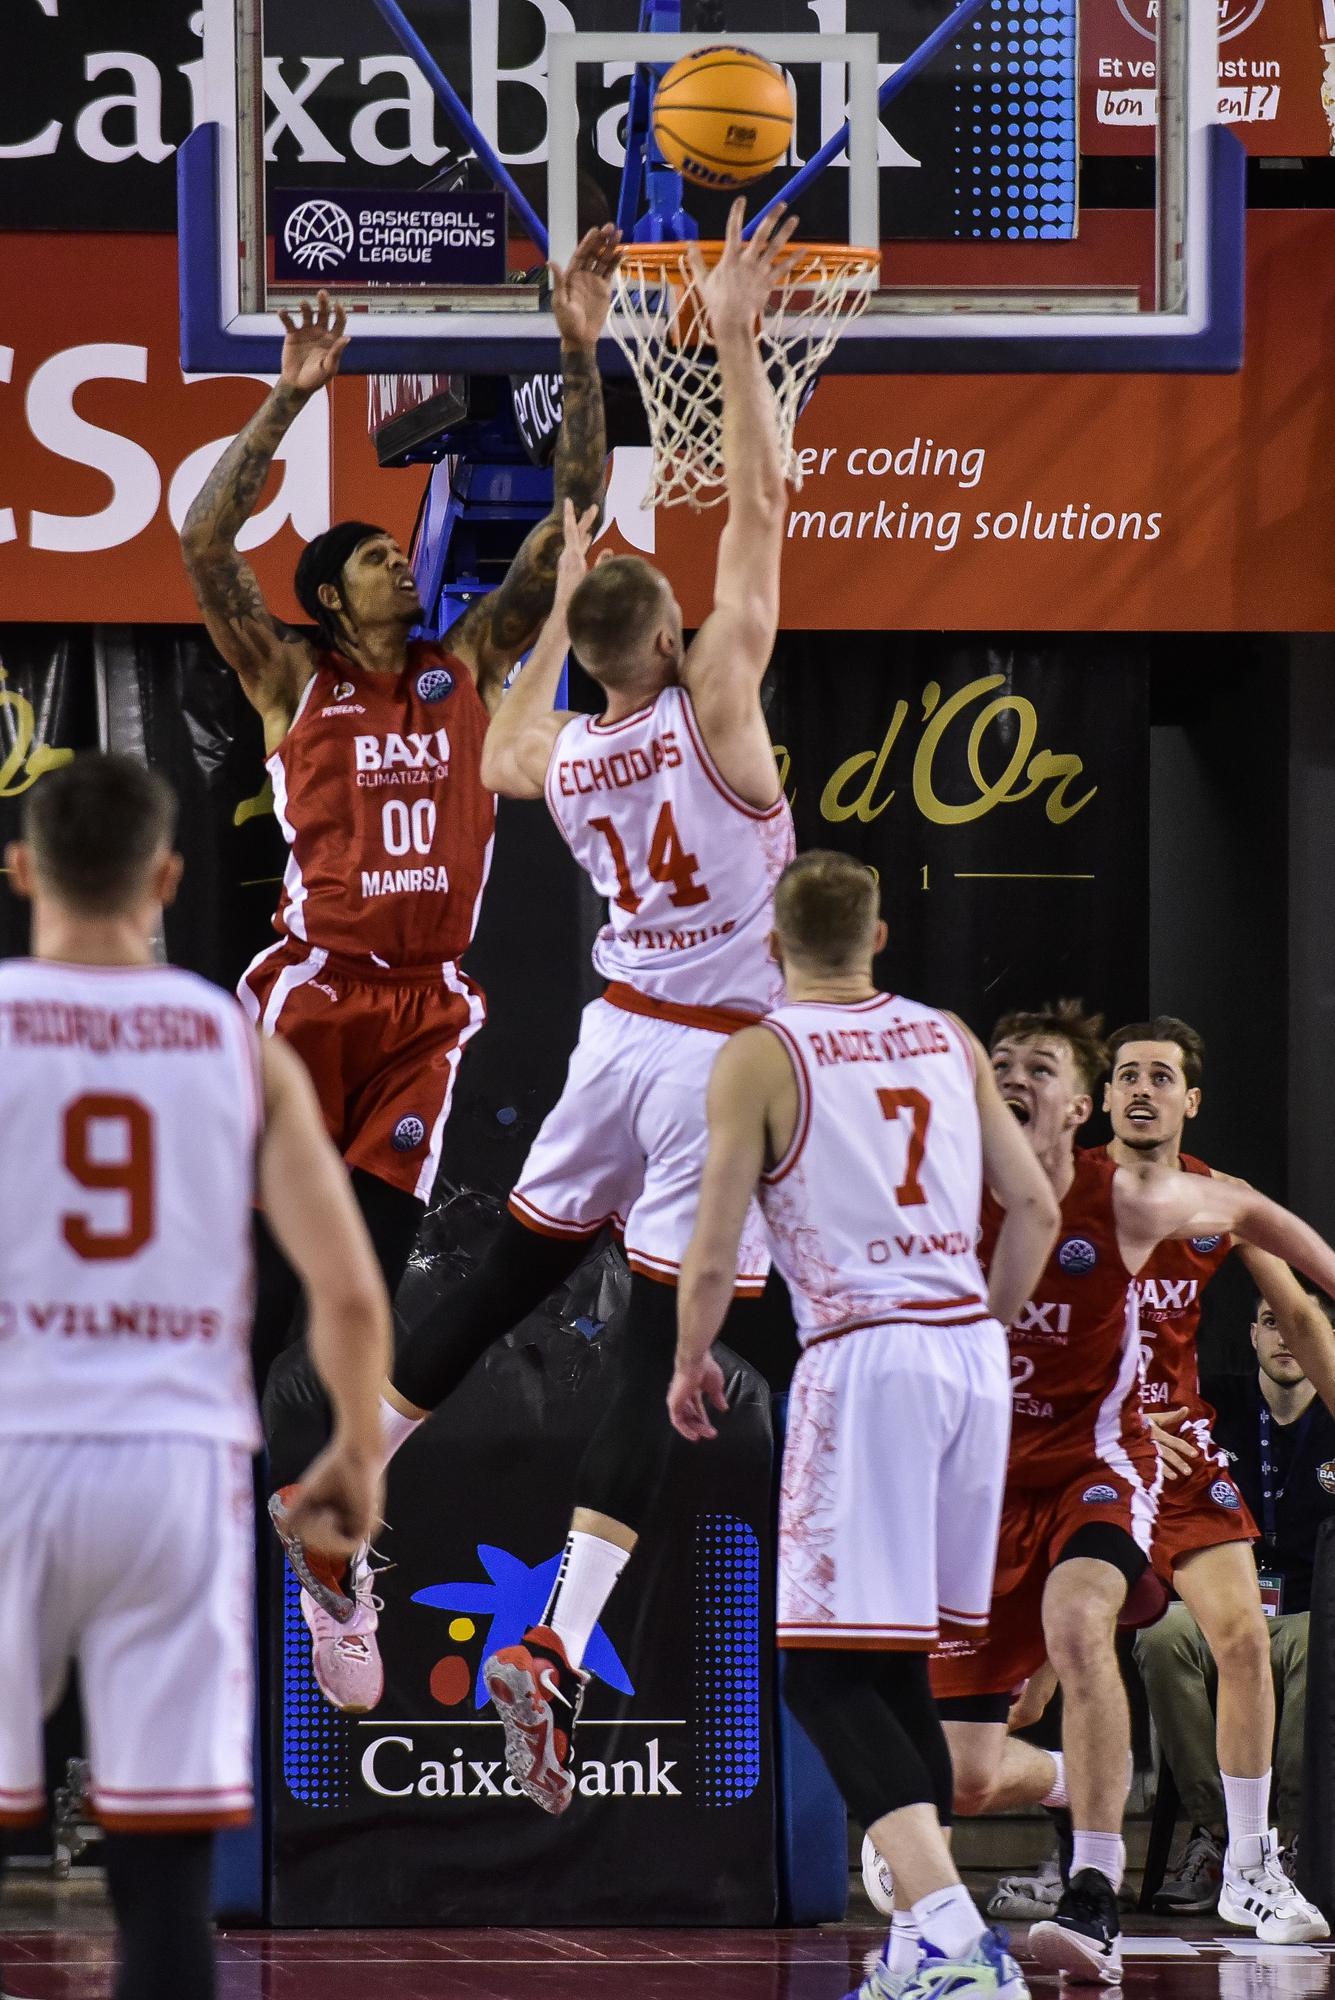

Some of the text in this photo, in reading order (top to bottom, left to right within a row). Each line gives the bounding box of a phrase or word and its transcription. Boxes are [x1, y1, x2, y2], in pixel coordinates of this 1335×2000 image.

[1098, 58, 1122, 78] Et
[1218, 58, 1247, 78] ust
[1251, 62, 1280, 78] un
[1104, 86, 1274, 118] bon ent?
[358, 210, 480, 228] BASKETBALL
[358, 228, 496, 247] CHAMPIONS
[358, 247, 433, 263] LEAGUE
[796, 437, 986, 488] er coding
[786, 501, 1163, 552] marking solutions
[353, 727, 450, 771] BAXI
[559, 731, 683, 797] ECHODAS
[819, 674, 1098, 825] d'Or
[381, 798, 437, 857] 00
[587, 800, 711, 915] 14
[875, 1086, 932, 1207] 7
[60, 1088, 156, 1263] 9
[1138, 1279, 1199, 1309] AXI
[27, 1300, 224, 1343] VILNIUS
[1014, 1399, 1054, 1419] ESA
[1138, 1381, 1169, 1404] ESA
